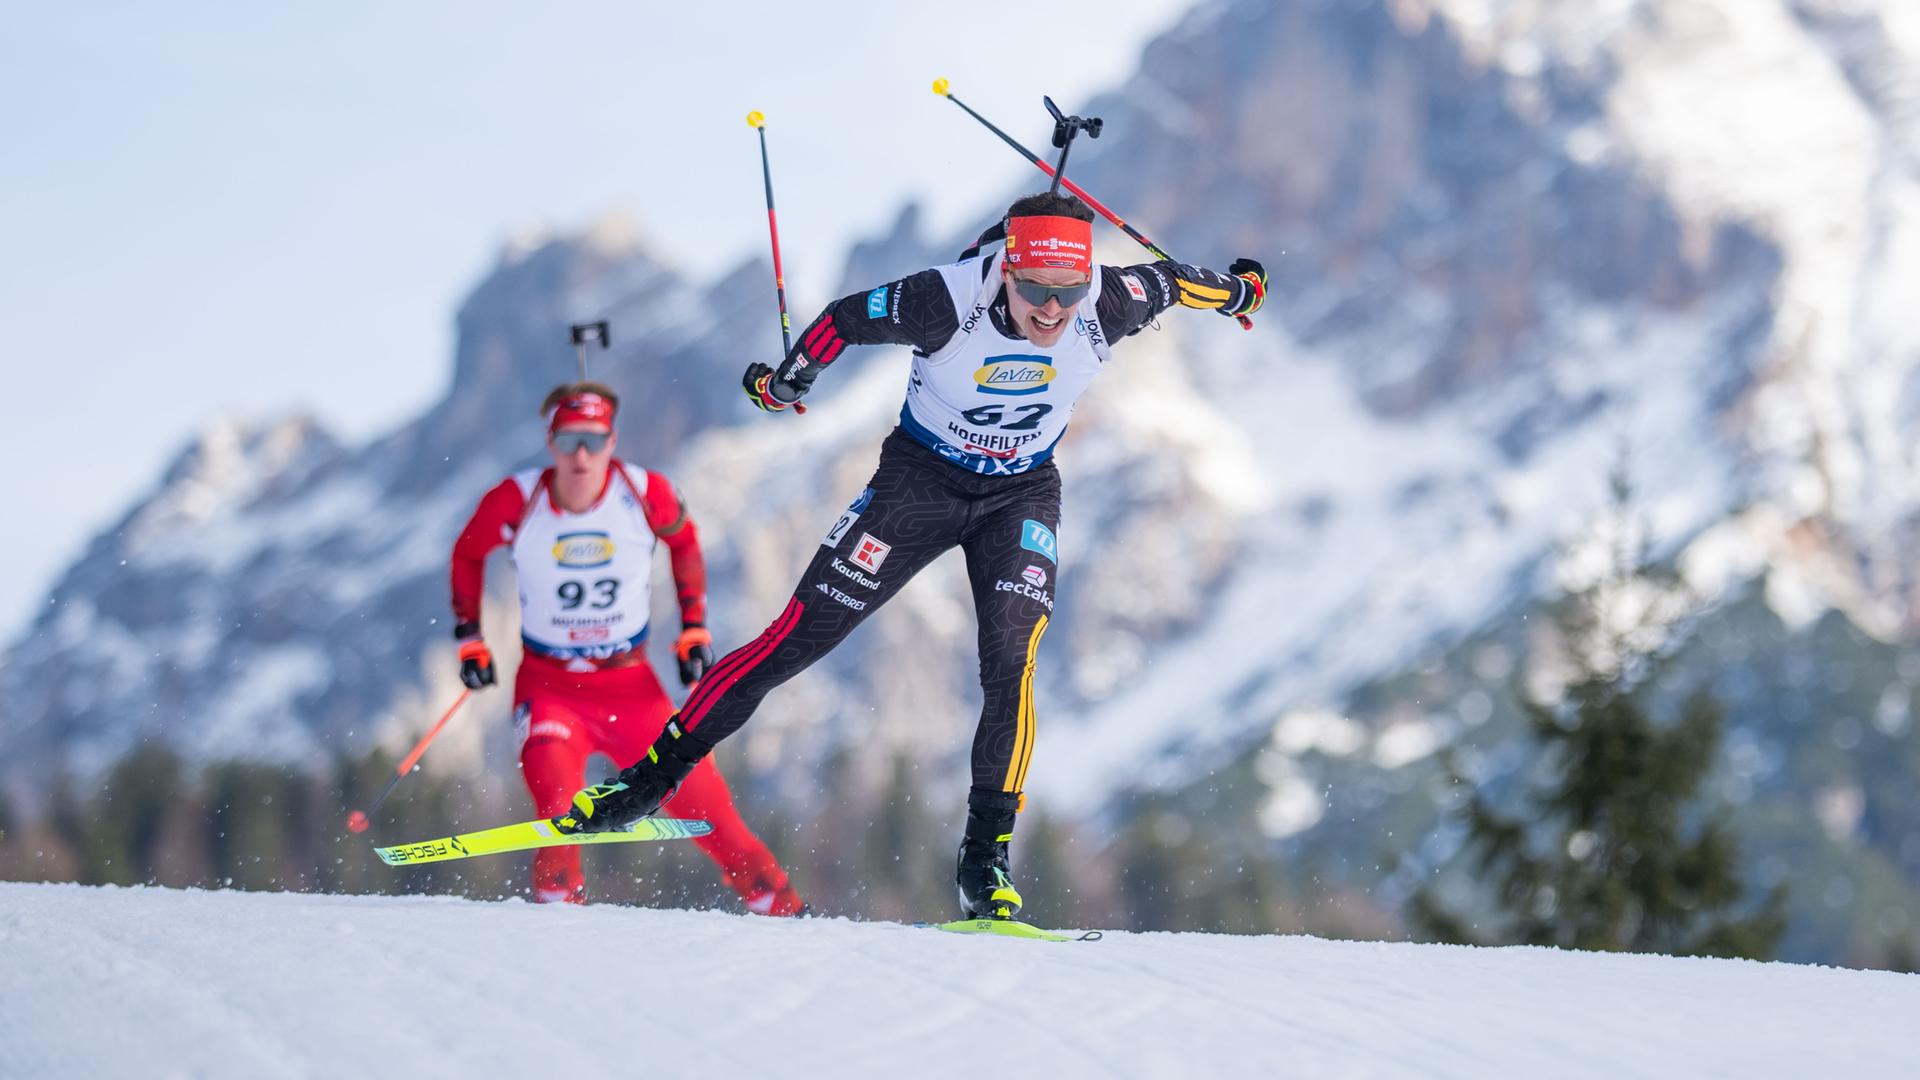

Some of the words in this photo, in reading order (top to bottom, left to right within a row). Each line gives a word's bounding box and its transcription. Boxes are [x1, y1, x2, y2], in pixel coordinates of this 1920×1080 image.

[961, 304, 986, 334] JOKA
[1084, 319, 1103, 345] JOKA
[784, 361, 802, 381] Kaufla
[961, 403, 1053, 431] 62
[948, 421, 1042, 450] HOCHFILZEN
[831, 557, 881, 590] Kaufland
[557, 578, 621, 611] 93
[829, 587, 868, 611] TERREX
[995, 579, 1054, 611] tectake
[389, 843, 447, 862] FISCHER
